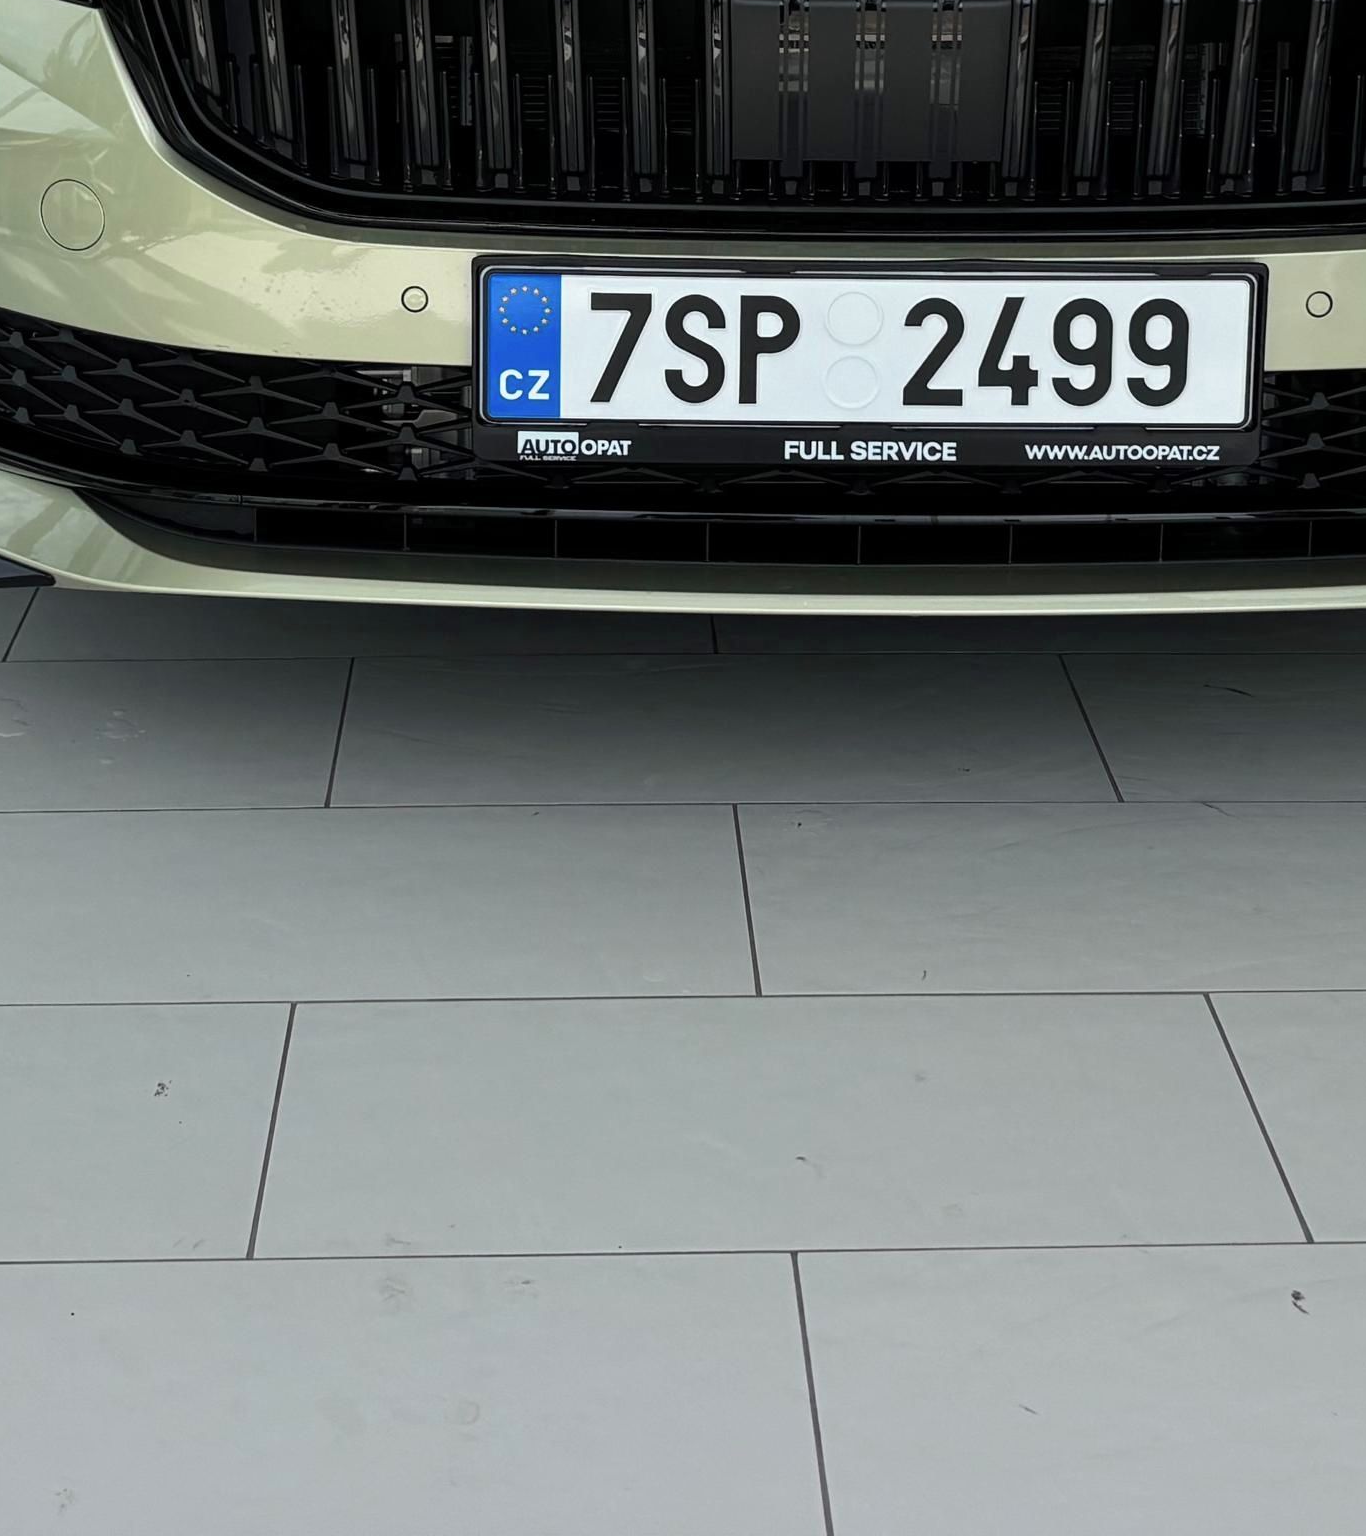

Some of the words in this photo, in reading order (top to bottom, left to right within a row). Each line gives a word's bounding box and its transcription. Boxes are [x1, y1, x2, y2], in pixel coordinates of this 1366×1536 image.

[590, 292, 801, 405] 7SP
[902, 296, 1190, 407] 2499
[499, 369, 550, 400] CZ
[784, 440, 844, 461] FULL
[850, 440, 957, 462] SERVICE
[1024, 444, 1221, 461] WWW.AUTOOPAT.CZ
